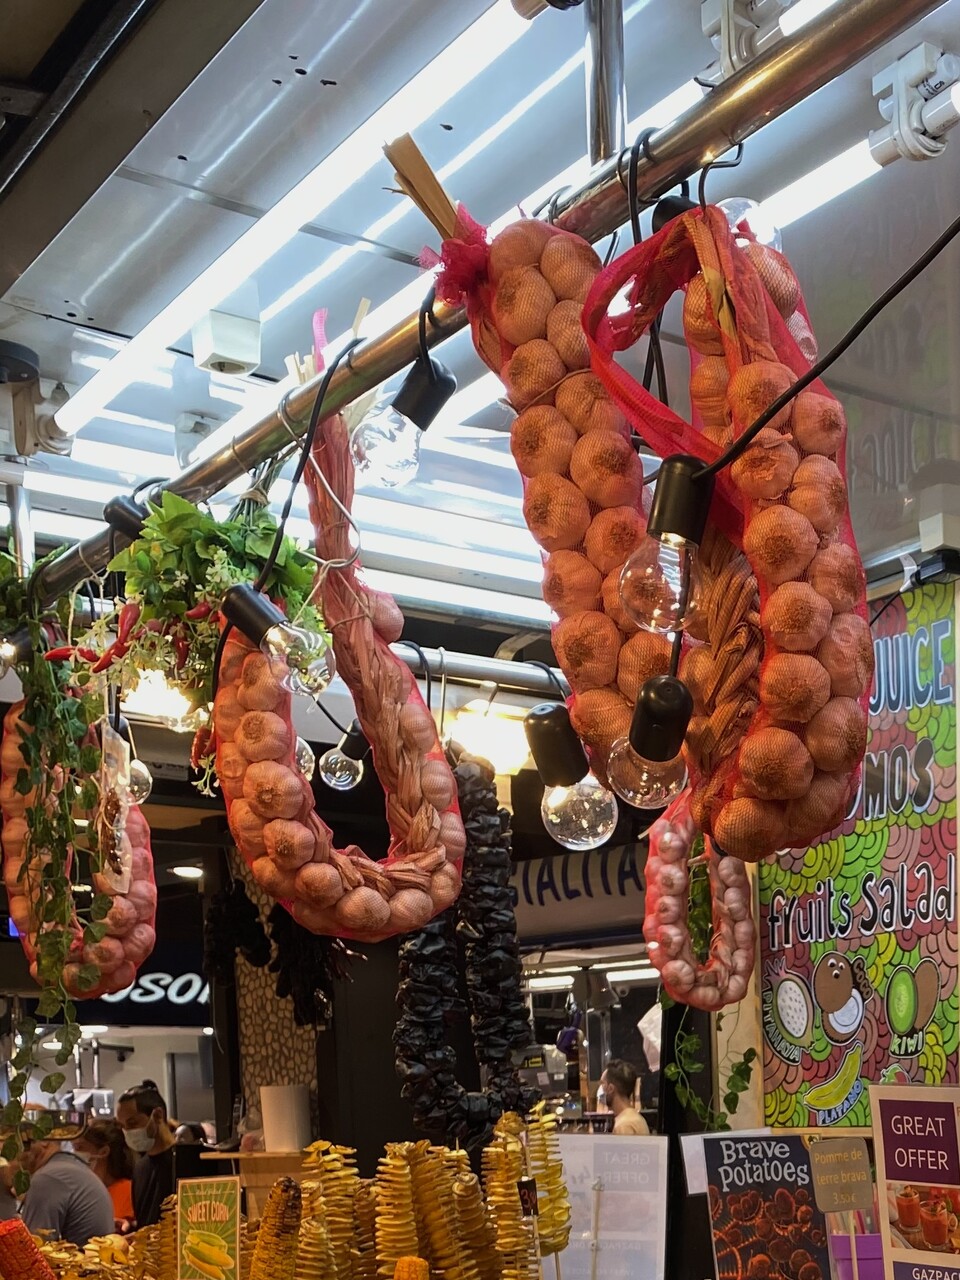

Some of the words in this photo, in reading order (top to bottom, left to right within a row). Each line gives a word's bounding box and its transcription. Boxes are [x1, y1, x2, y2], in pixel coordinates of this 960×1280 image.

[868, 619, 953, 716] JUICE
[844, 738, 935, 822] MOS
[891, 1031, 925, 1056] KIWI
[818, 1080, 863, 1125] PLATANO
[891, 1115, 946, 1137] GREAT
[720, 1140, 790, 1165] Brave
[814, 1152, 849, 1165] Pomme
[851, 1148, 863, 1160] de
[894, 1147, 950, 1171] OFFER
[817, 1173, 840, 1185] terre
[841, 1170, 867, 1183] brava
[188, 1201, 210, 1222] SWEET
[211, 1200, 229, 1221] CORN
